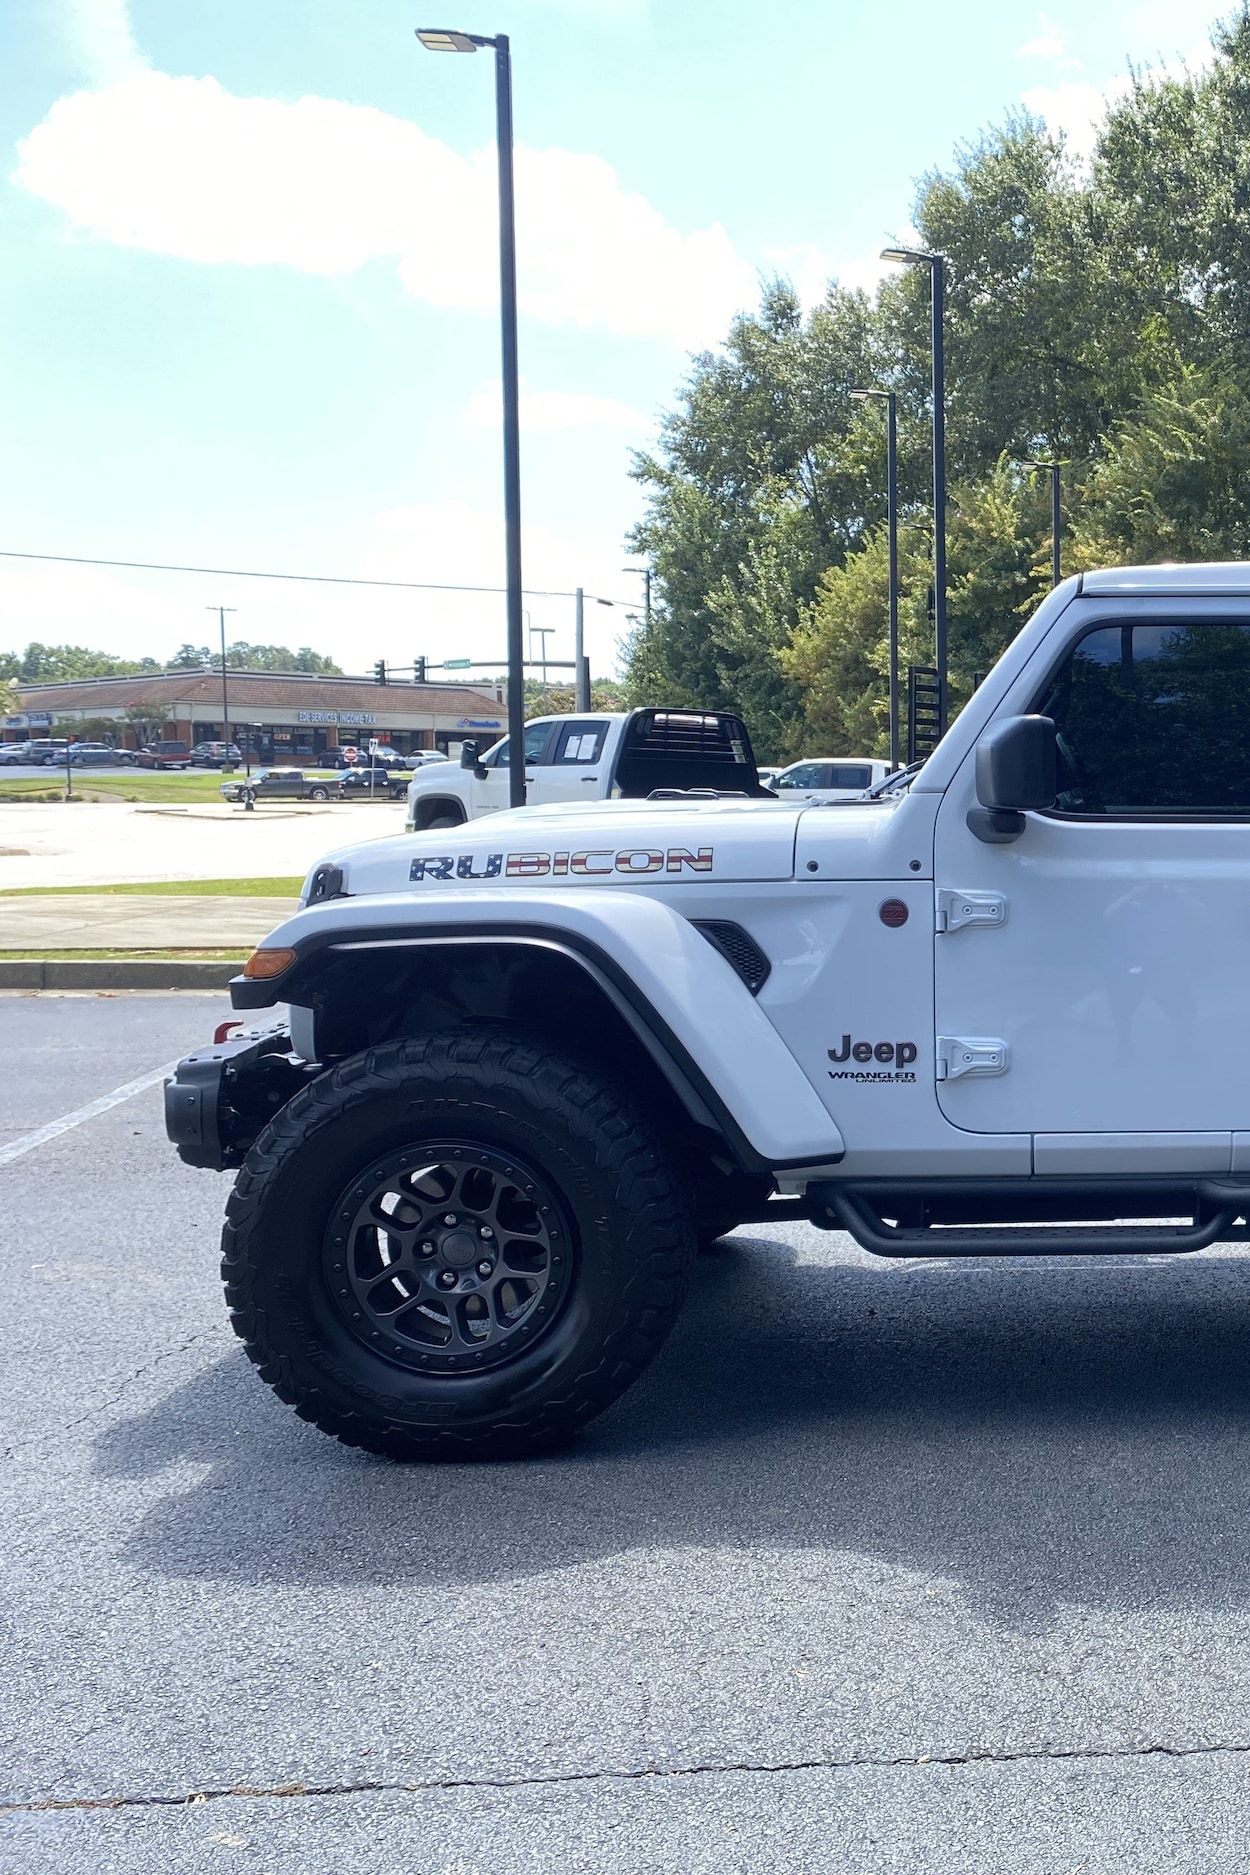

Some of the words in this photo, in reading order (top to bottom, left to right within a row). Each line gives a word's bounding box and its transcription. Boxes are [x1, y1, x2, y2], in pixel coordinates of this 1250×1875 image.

[409, 847, 714, 881] RUBICON
[827, 1034, 918, 1069] Jeep
[827, 1071, 916, 1079] WRANGLER
